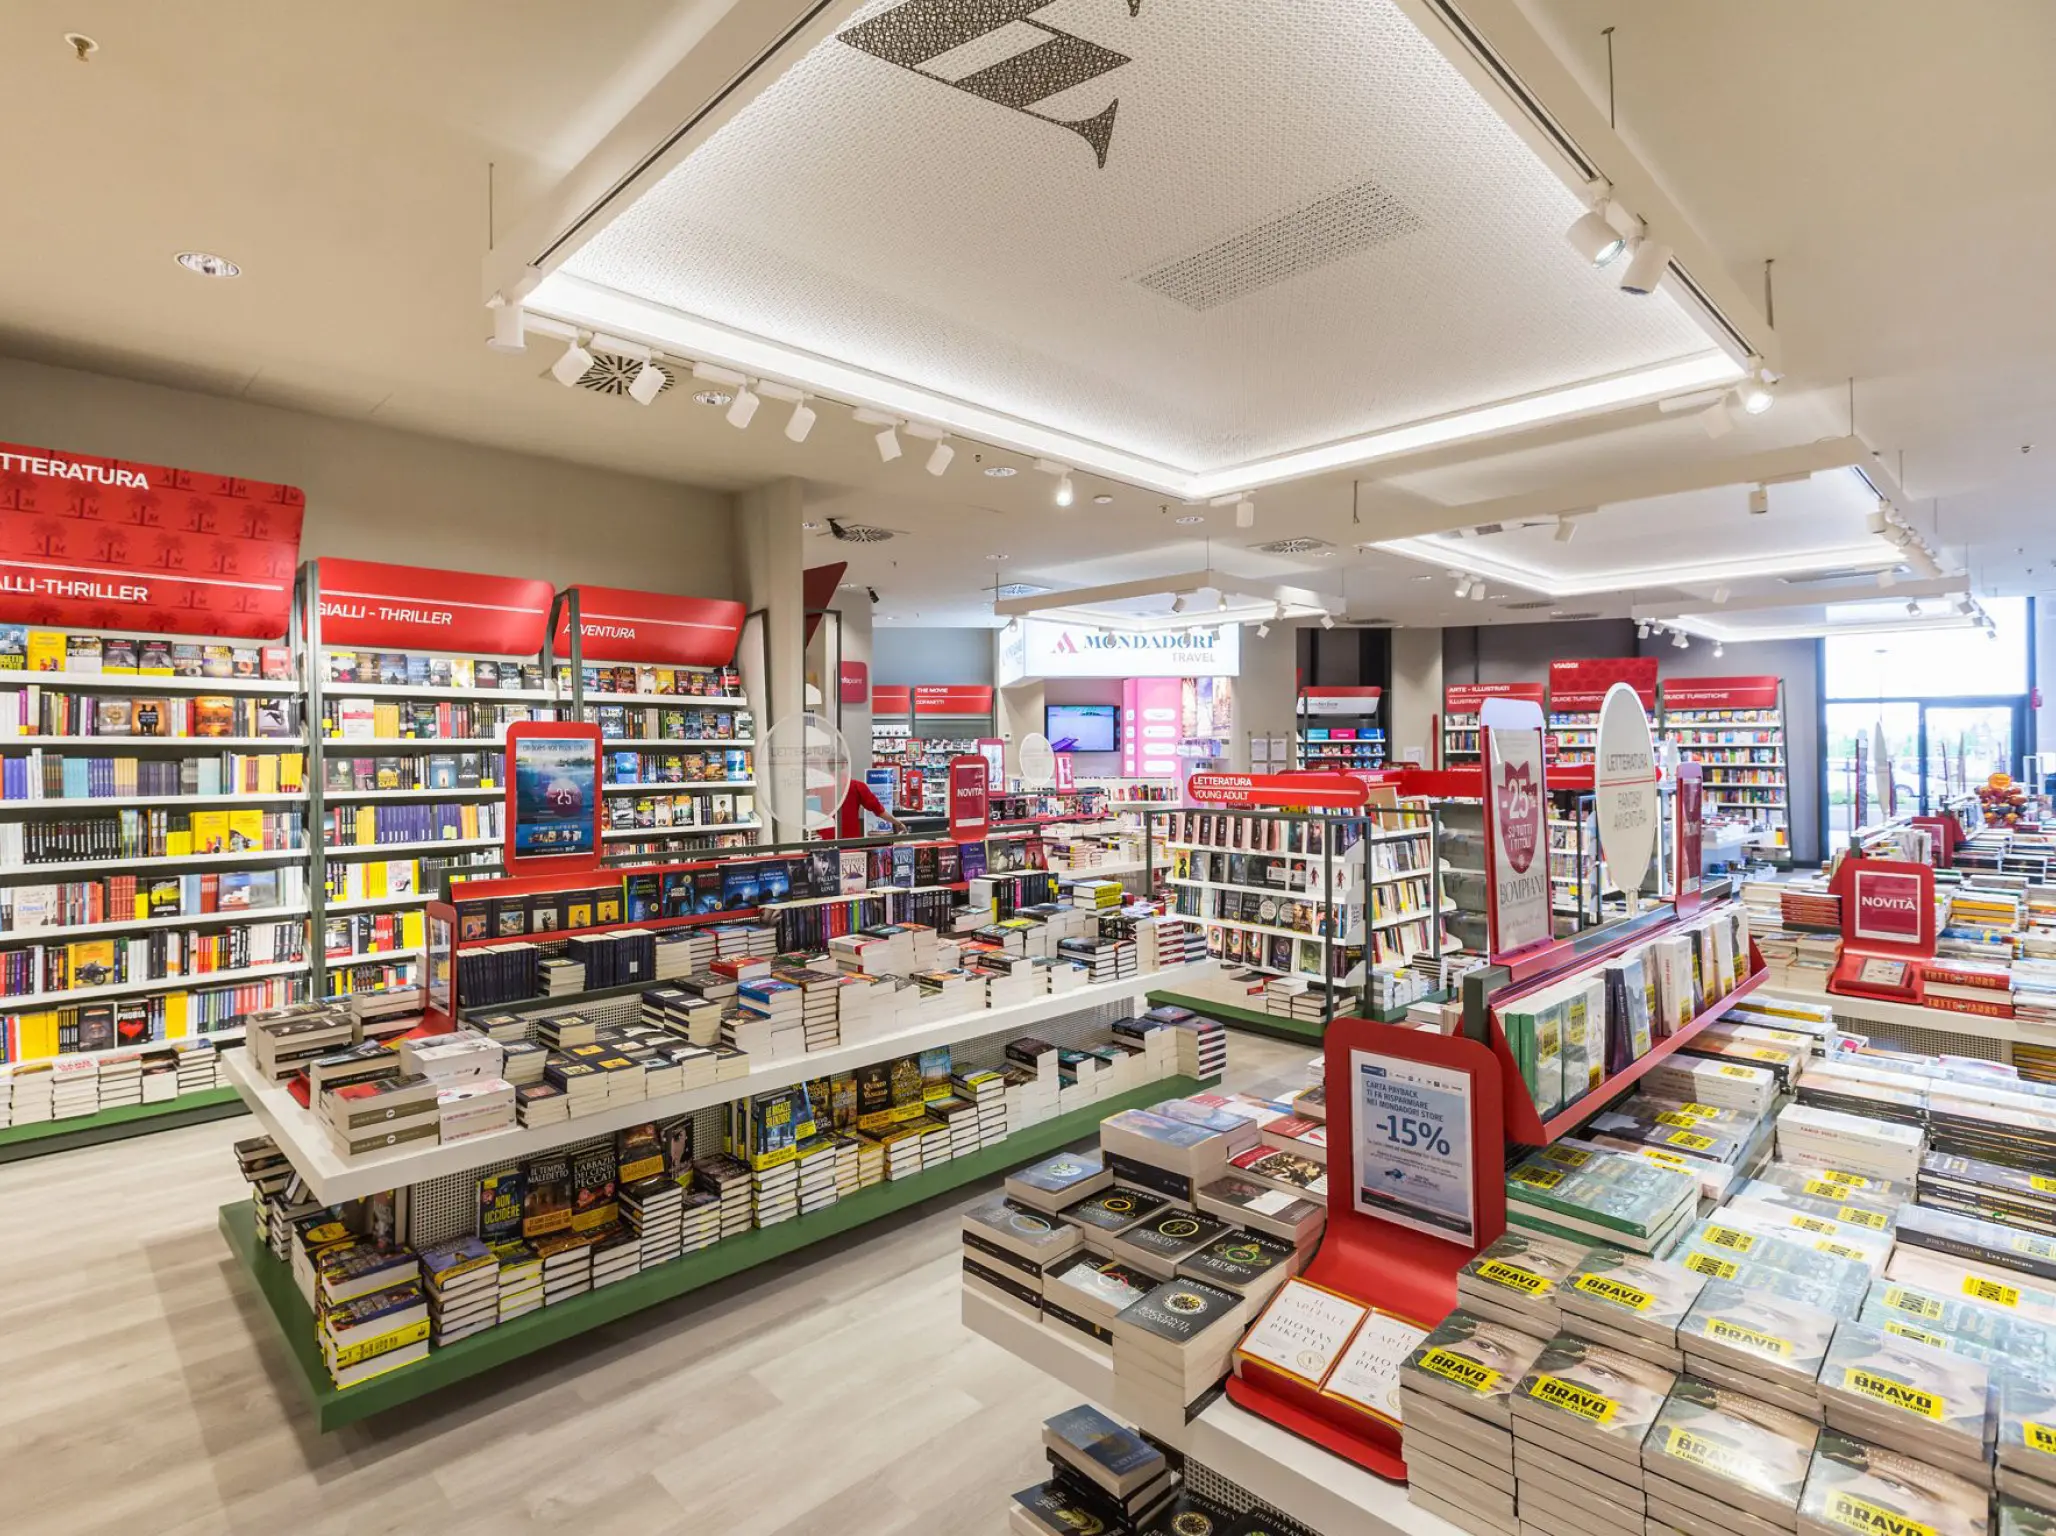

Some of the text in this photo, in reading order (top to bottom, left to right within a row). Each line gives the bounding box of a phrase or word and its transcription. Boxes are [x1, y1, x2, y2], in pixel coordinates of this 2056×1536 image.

[379, 606, 453, 626] THRILLER
[563, 623, 636, 640] AVENTURA
[1172, 652, 1216, 663] TRAVEL
[1193, 776, 1253, 787] LETTERATURA
[1194, 790, 1249, 801] YOUNG ADULT
[841, 863, 865, 875] KING
[1861, 895, 1916, 911] NOVITÀ
[1366, 1080, 1387, 1092] CARTA
[1374, 1090, 1382, 1099] FA
[1384, 1092, 1429, 1110] RISPARMIARE
[1379, 1100, 1420, 1117] MONDADORI
[1421, 1110, 1444, 1123] STORE
[1376, 1115, 1450, 1156] -15%
[527, 1169, 569, 1184] MALEDETTO
[539, 1163, 566, 1175] TEMPIO
[495, 1194, 512, 1208] NON
[484, 1206, 521, 1225] UCCIDERE
[1487, 1262, 1542, 1289] BRAVO
[1199, 1284, 1236, 1301] TOLKIEN
[1585, 1277, 1646, 1303] BRAVO
[1284, 1298, 1346, 1326] CAPITALE
[1270, 1322, 1325, 1352] PIKETTY
[1276, 1315, 1333, 1344] THOMAS
[1713, 1324, 1782, 1353] BRAVO
[1368, 1332, 1412, 1352] CAPIT
[1361, 1350, 1400, 1372] THO
[1431, 1353, 1488, 1383] BRAVO
[1541, 1381, 1608, 1414] BRAVO
[1854, 1375, 1932, 1410] BRAVO
[1544, 1394, 1564, 1406] LIBRI
[1579, 1407, 1601, 1420] EURO
[1836, 1501, 1924, 1536] BRAVO
